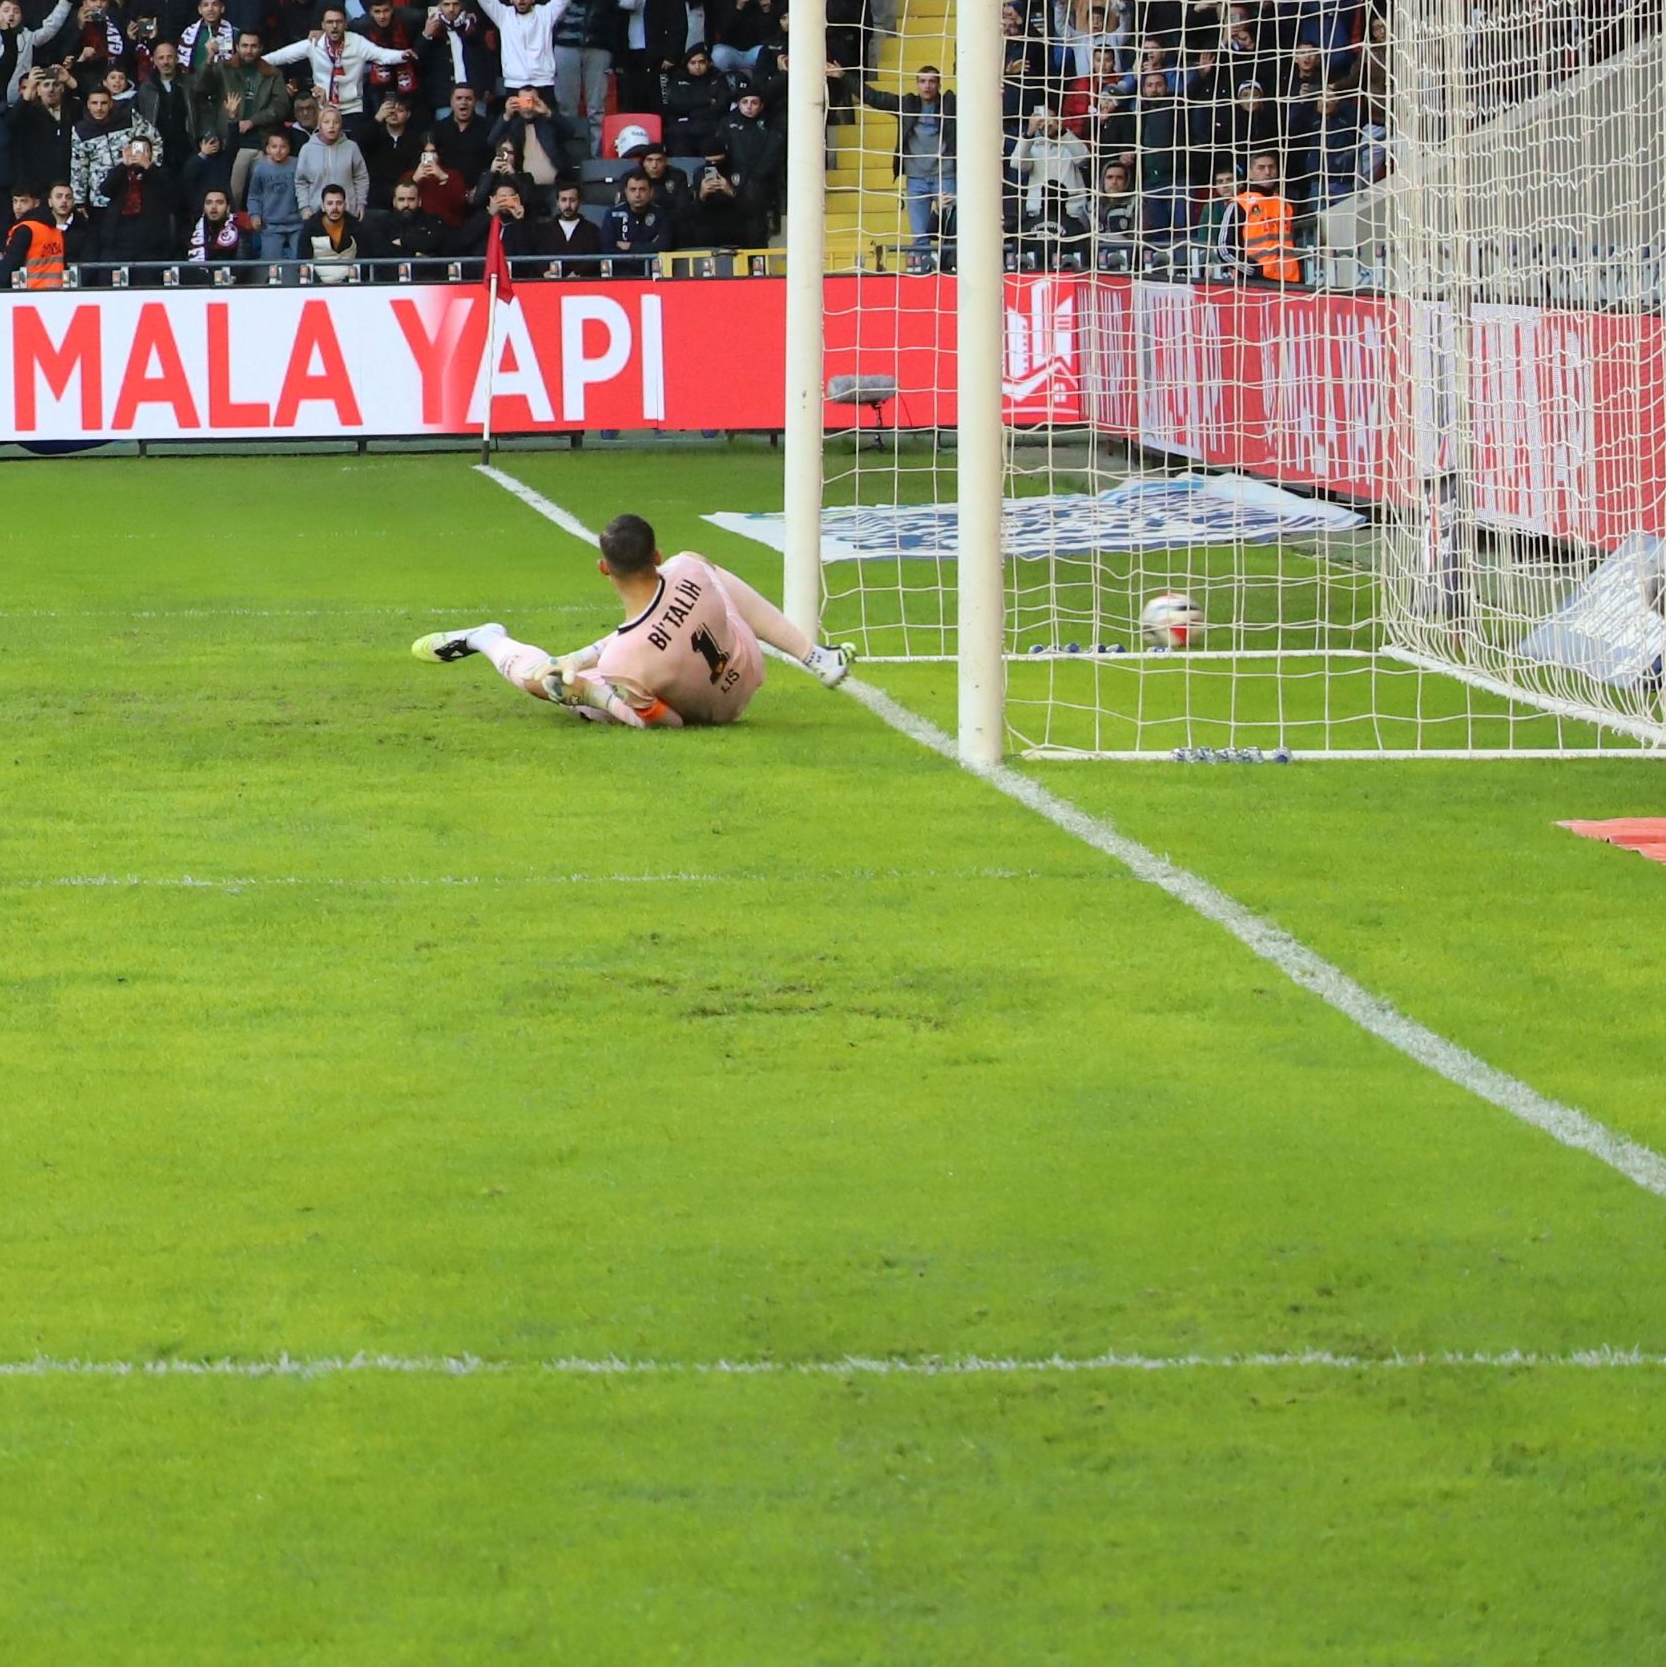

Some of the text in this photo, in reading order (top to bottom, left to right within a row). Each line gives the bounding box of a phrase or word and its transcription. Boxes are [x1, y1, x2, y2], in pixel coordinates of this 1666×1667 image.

[11, 293, 666, 432] MALA YAPI
[690, 622, 729, 686] 1
